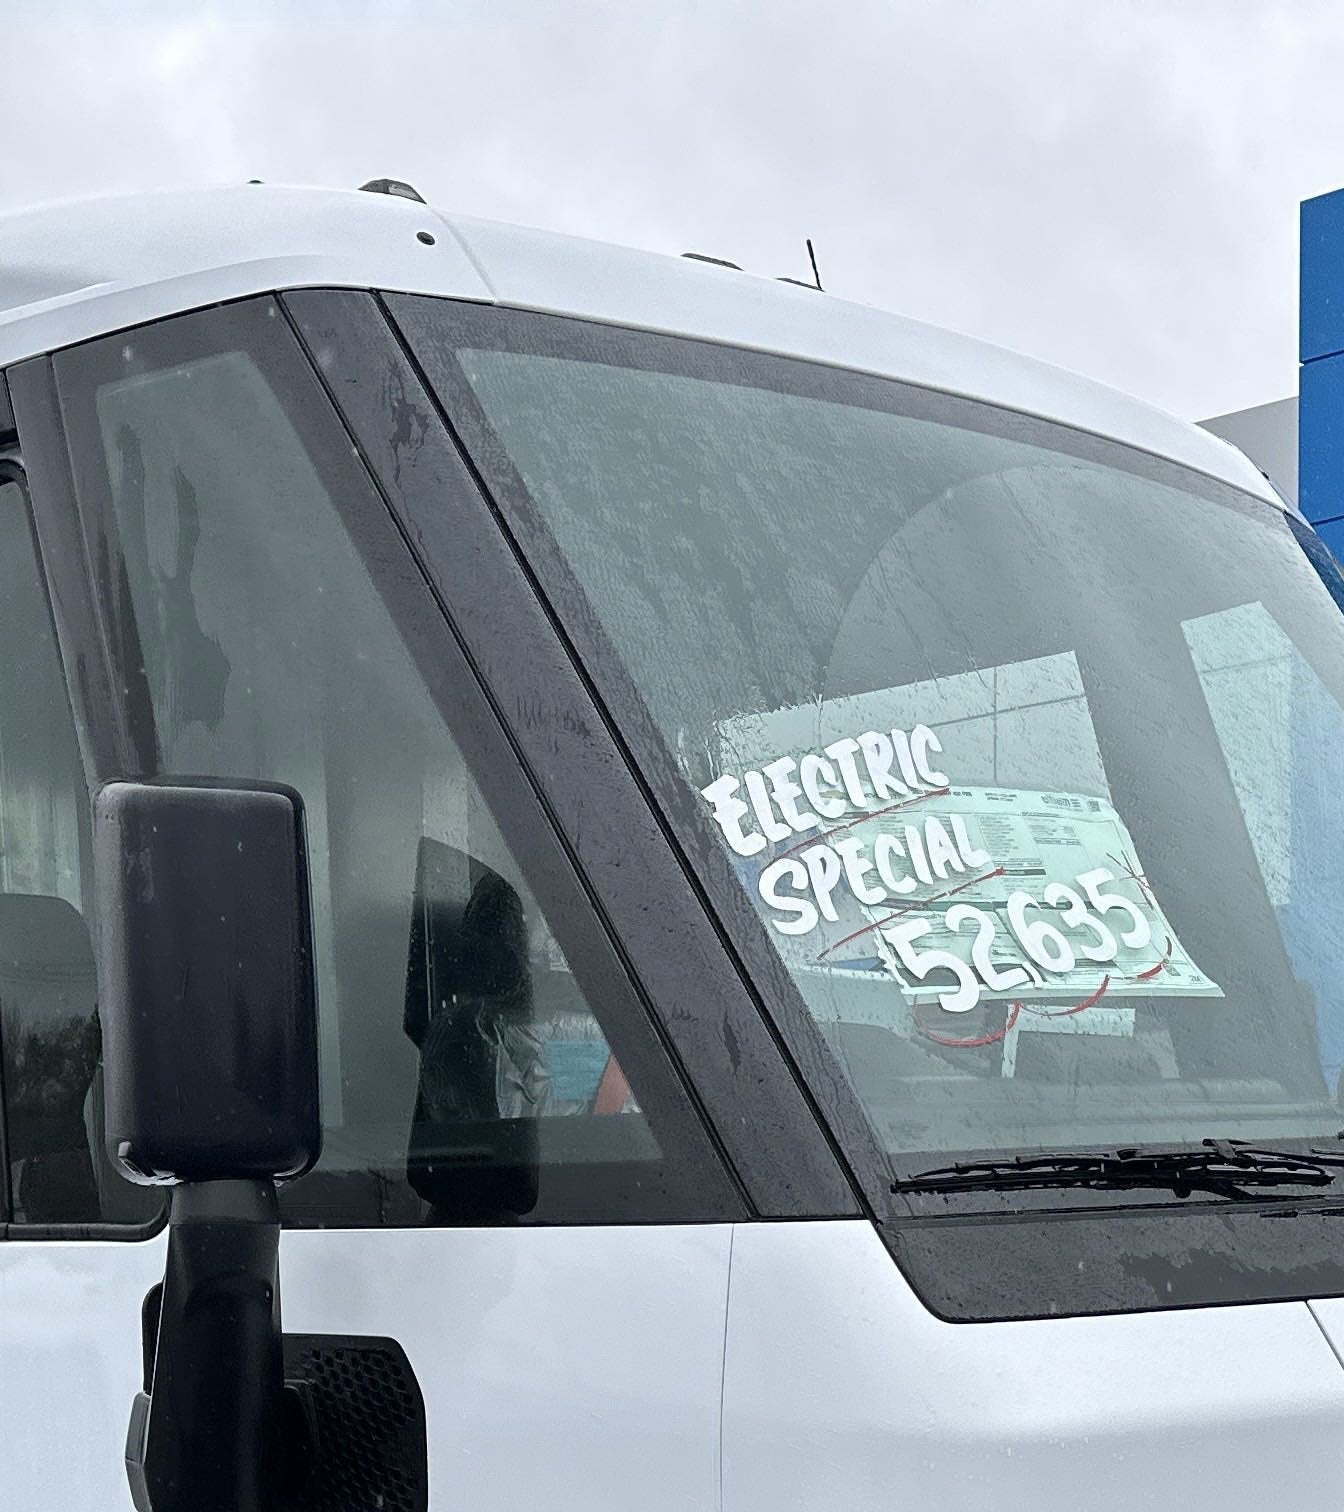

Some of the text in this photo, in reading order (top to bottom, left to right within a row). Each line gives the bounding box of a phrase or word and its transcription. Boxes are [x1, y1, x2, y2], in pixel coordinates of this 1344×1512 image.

[700, 723, 950, 857] ELECTRIC
[758, 814, 991, 936] SPECIAL
[886, 867, 1153, 1014] 52,635
